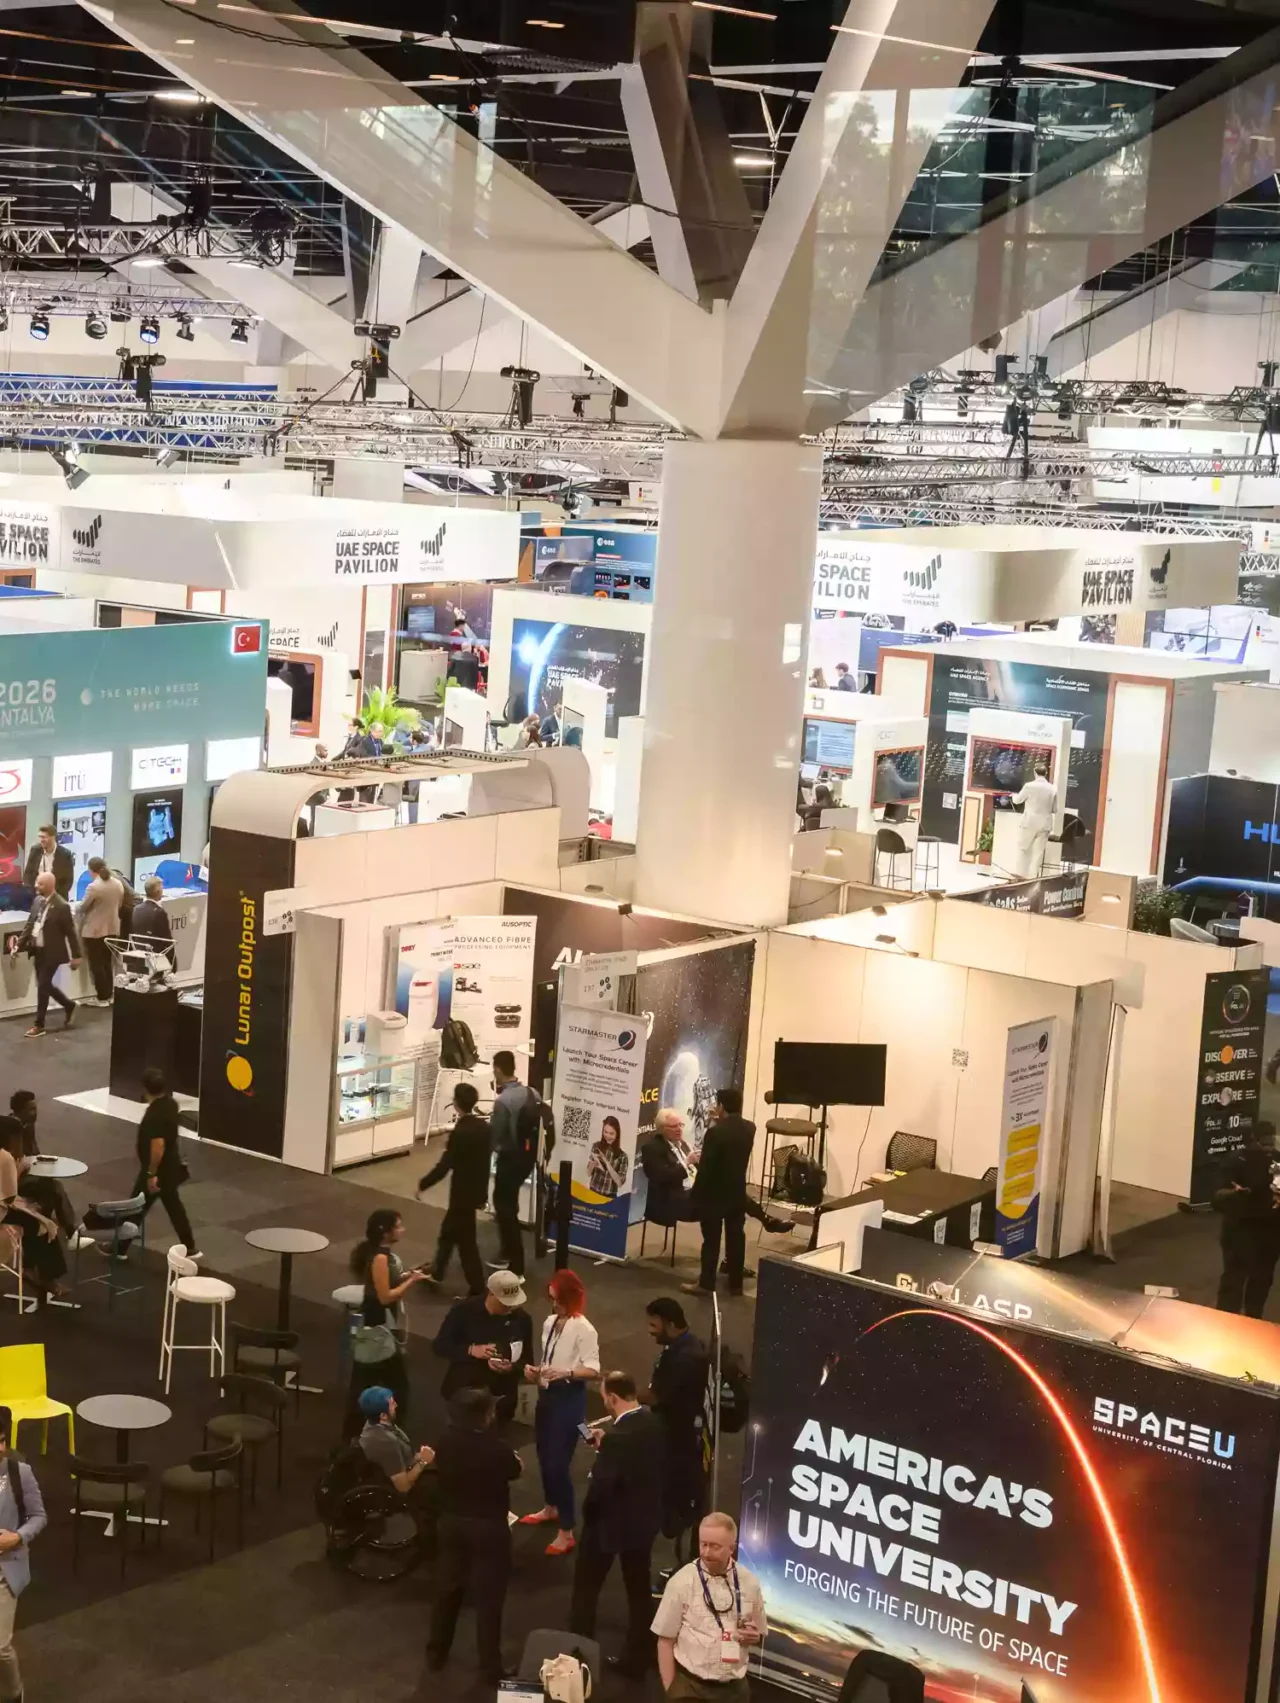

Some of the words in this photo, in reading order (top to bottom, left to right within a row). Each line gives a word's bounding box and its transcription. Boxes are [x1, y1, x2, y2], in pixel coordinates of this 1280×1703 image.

[9, 523, 49, 541] SPACE
[336, 541, 360, 557] UAE
[362, 540, 400, 556] SPACE
[334, 558, 399, 574] PAVILION
[819, 563, 871, 582] SPACE
[1083, 571, 1103, 587] UAE
[1104, 569, 1135, 587] SPACE
[814, 580, 870, 600] ILION
[1081, 586, 1133, 607] PAVILION
[100, 688, 120, 699] THE
[126, 685, 160, 697] WORLD
[166, 682, 199, 693] NEEDS
[1043, 890, 1062, 905] Power
[1062, 885, 1084, 902] Control
[237, 895, 257, 980] Outpost
[453, 936, 504, 944] ADVANCED
[506, 936, 532, 944] FIBRE
[235, 986, 252, 1045] Lunar
[568, 1024, 617, 1041] STARMASTER
[562, 1045, 583, 1056] Launch
[584, 1048, 598, 1059] Your
[599, 1053, 617, 1064] Space
[618, 1058, 638, 1068] Career
[1204, 1048, 1248, 1063] DISCVER
[568, 1056, 581, 1064] with
[582, 1059, 630, 1074] Microcredentials
[1206, 1070, 1246, 1083] BSERVE
[561, 1093, 582, 1103] Register
[584, 1097, 595, 1106] Your
[639, 1087, 659, 1104] ACE
[1201, 1090, 1243, 1105] EXPLRE
[1228, 1115, 1240, 1128] 10
[1210, 1136, 1228, 1145] Google
[1228, 1134, 1243, 1143] Cloud
[1093, 1396, 1236, 1459] SPACEU
[1092, 1424, 1140, 1444] UNIVERSITY
[1142, 1439, 1153, 1448] OF
[1156, 1443, 1193, 1460] CENTRAL
[1196, 1455, 1233, 1471] FLORIDA
[793, 1418, 1054, 1528] AMERICA'S
[789, 1464, 943, 1544] SPACE
[787, 1508, 1078, 1636] UNIVERSITY
[784, 1559, 861, 1604] FORGING
[865, 1587, 900, 1618] THE
[903, 1600, 975, 1645] FUTURE
[979, 1628, 1005, 1652] OF
[1008, 1637, 1069, 1677] SPACE
